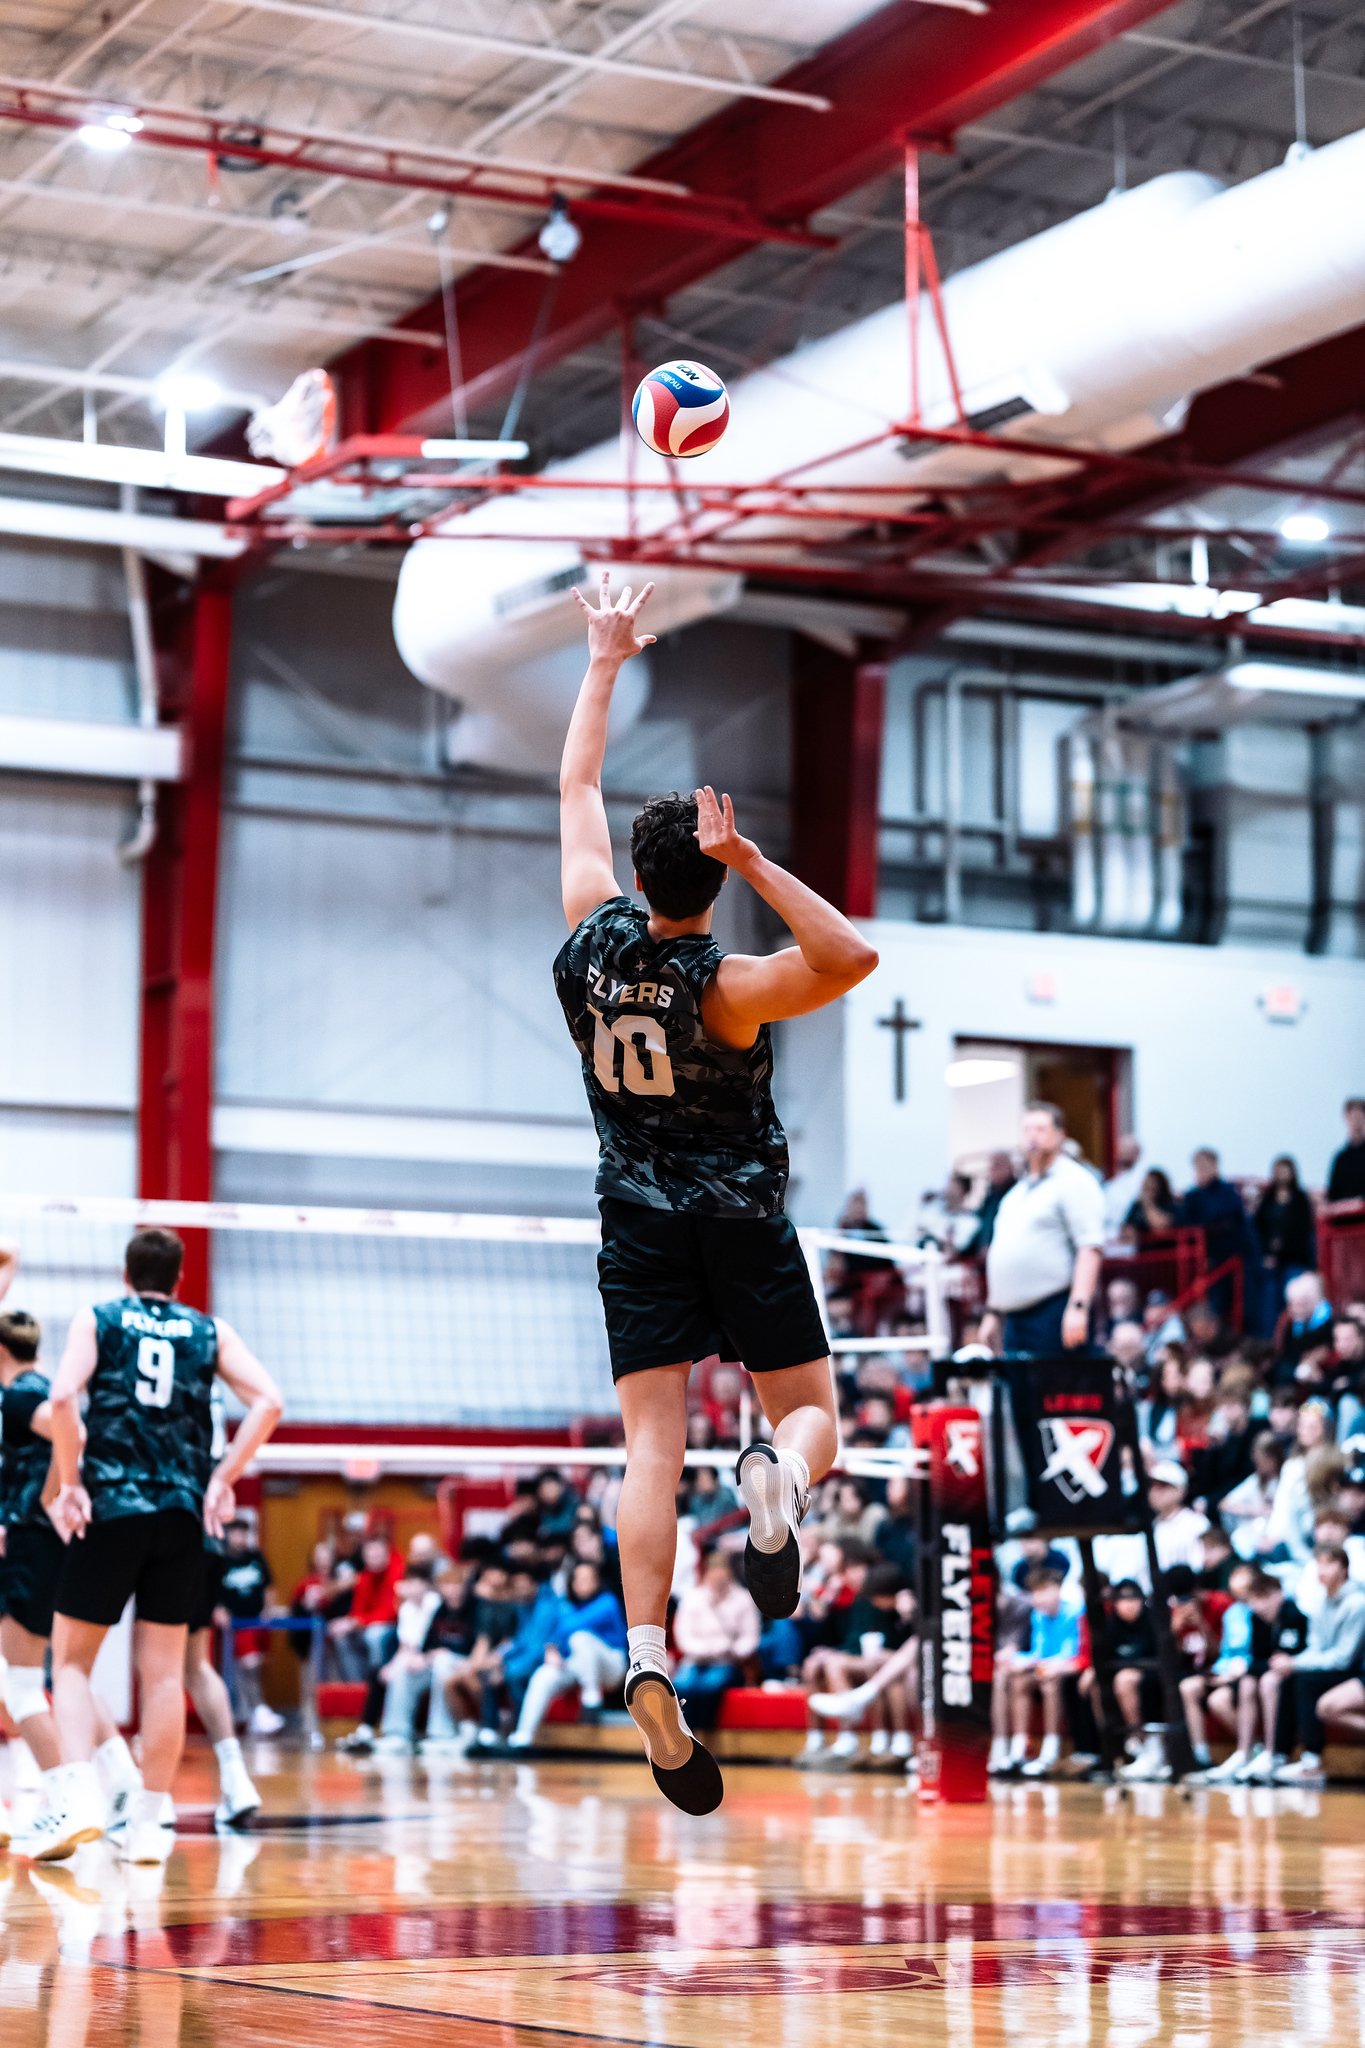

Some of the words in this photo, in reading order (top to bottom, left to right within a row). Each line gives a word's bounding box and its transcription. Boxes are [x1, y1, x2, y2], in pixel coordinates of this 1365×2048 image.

[586, 963, 675, 1009] FLYERS
[586, 1002, 676, 1098] 10
[121, 1310, 194, 1338] FLYERS
[135, 1336, 175, 1409] 9
[941, 1523, 972, 1707] FLYERS
[971, 1547, 994, 1683] LEWIS
